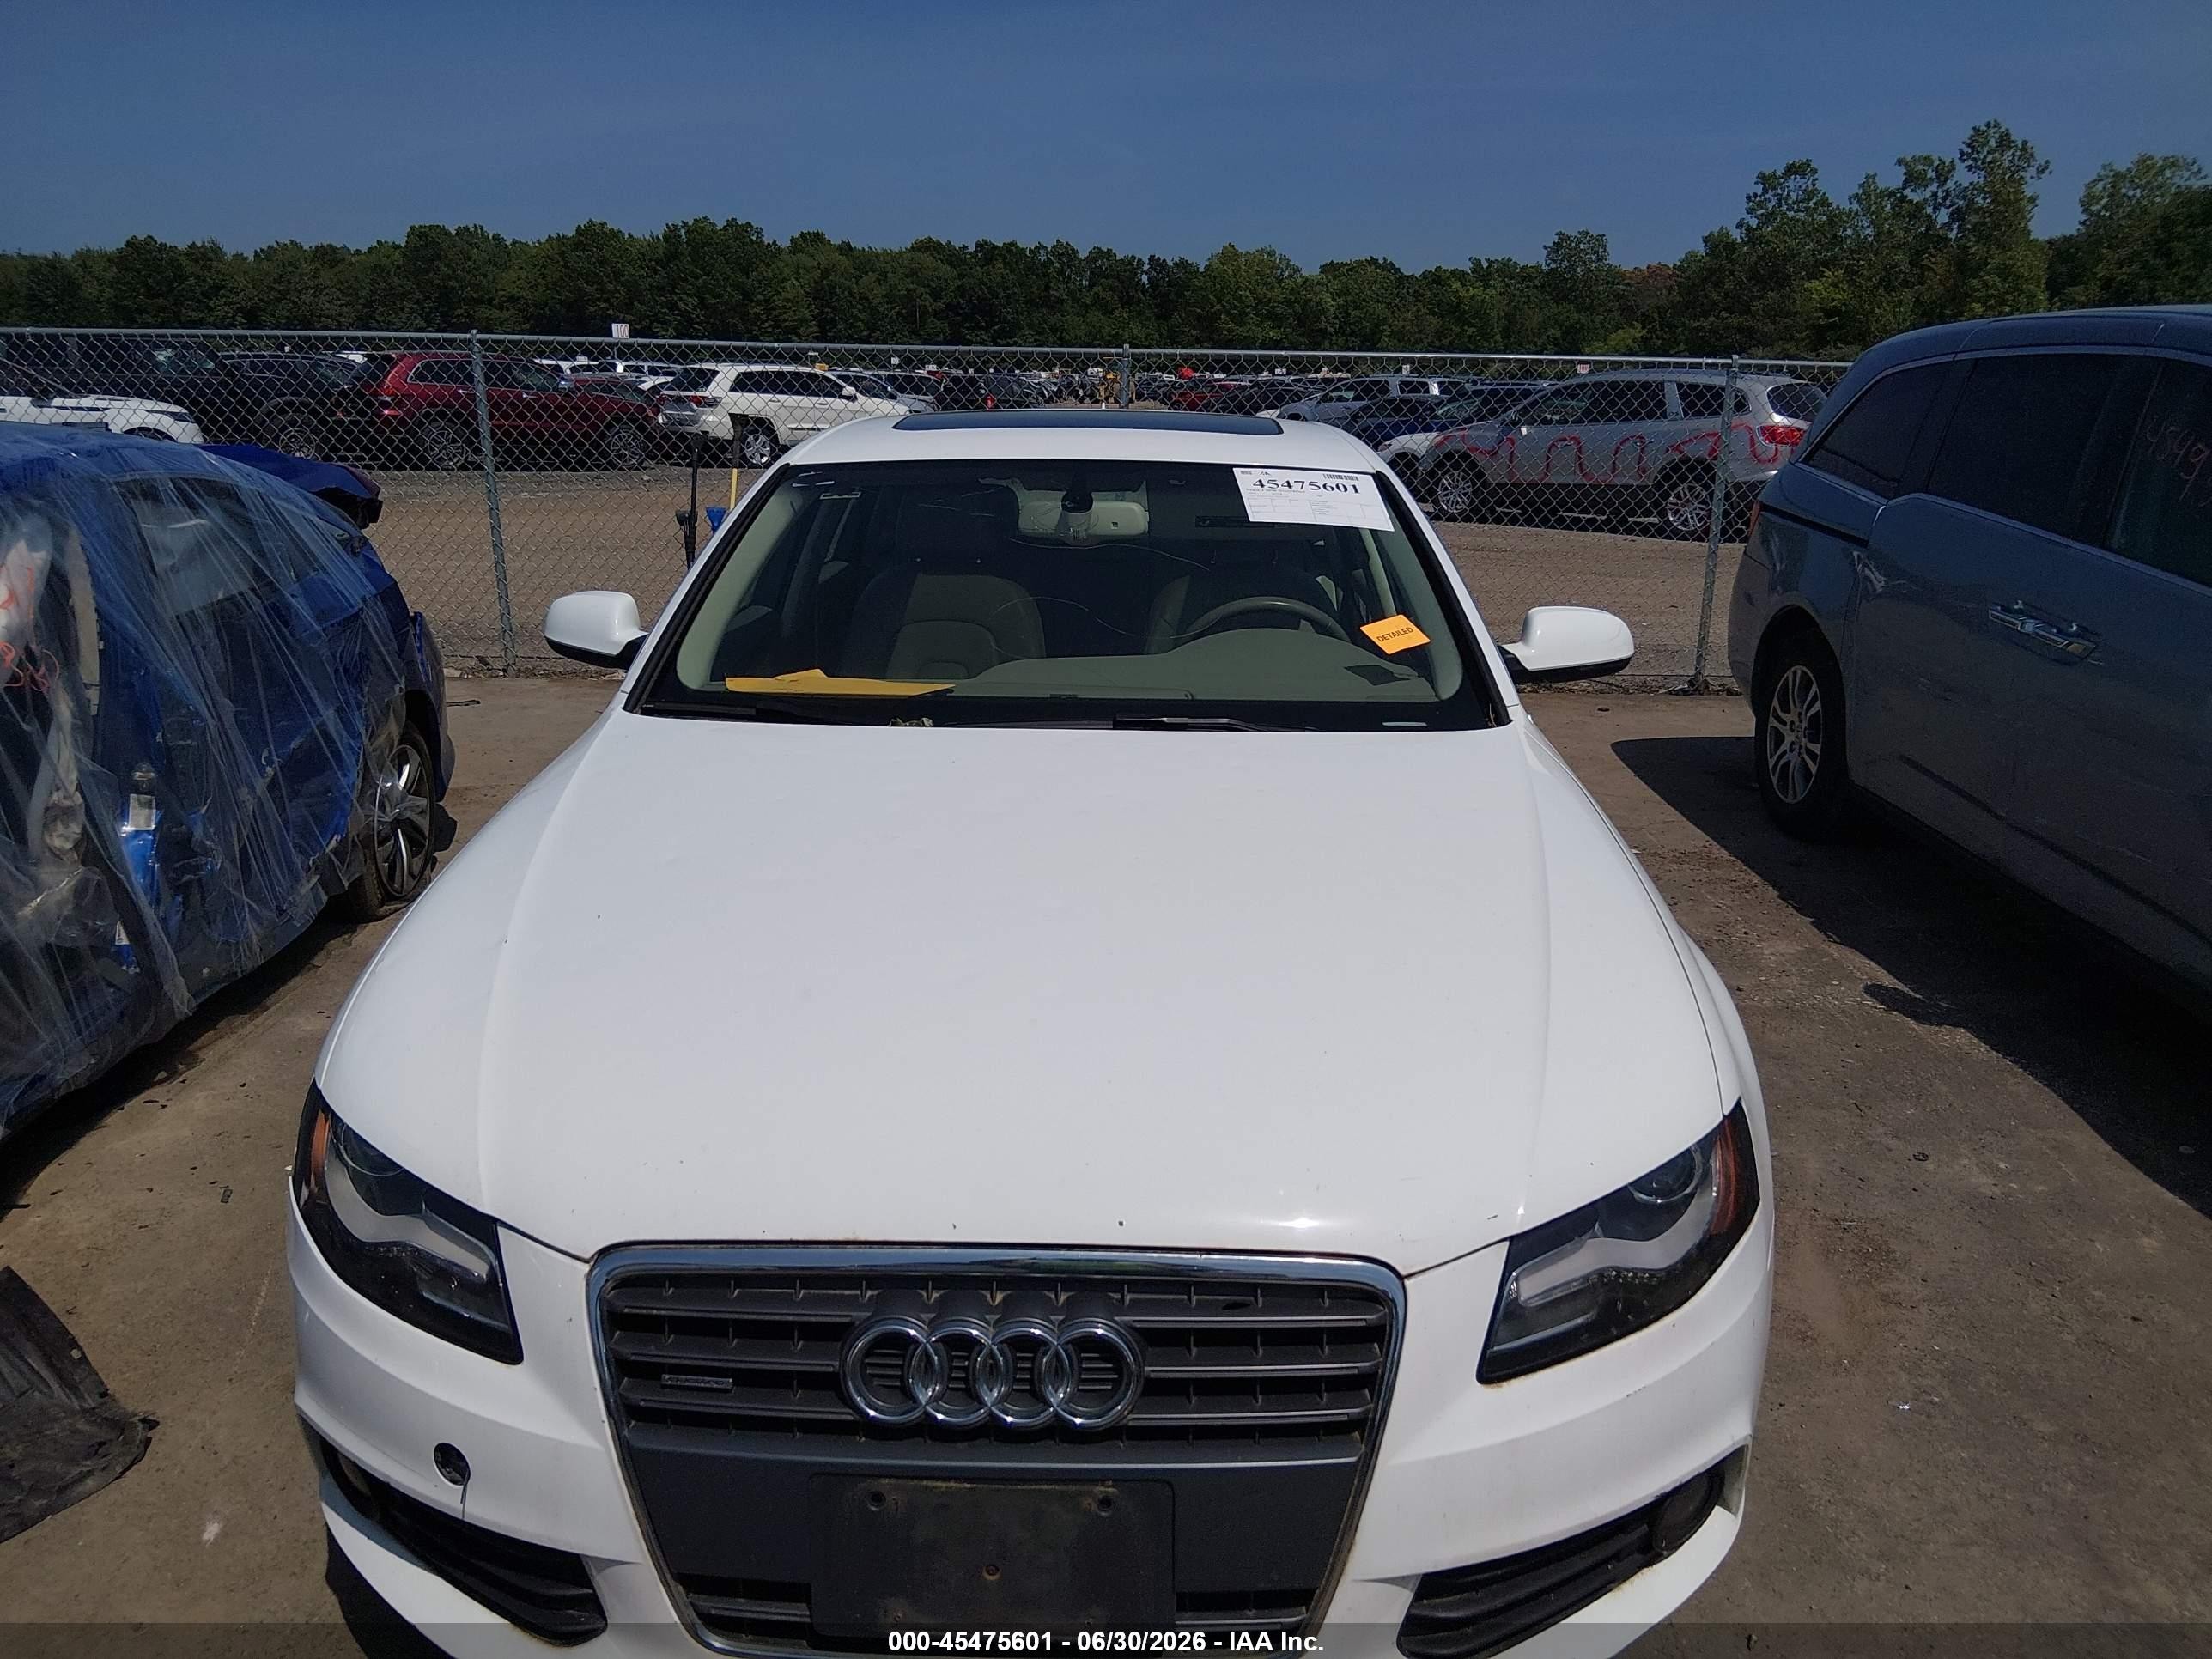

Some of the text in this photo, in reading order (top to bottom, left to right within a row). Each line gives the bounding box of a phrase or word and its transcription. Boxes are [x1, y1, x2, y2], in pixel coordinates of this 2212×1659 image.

[616, 325, 629, 337] 100
[1252, 478, 1360, 495] 45475601
[1376, 627, 1414, 642] DETAILED
